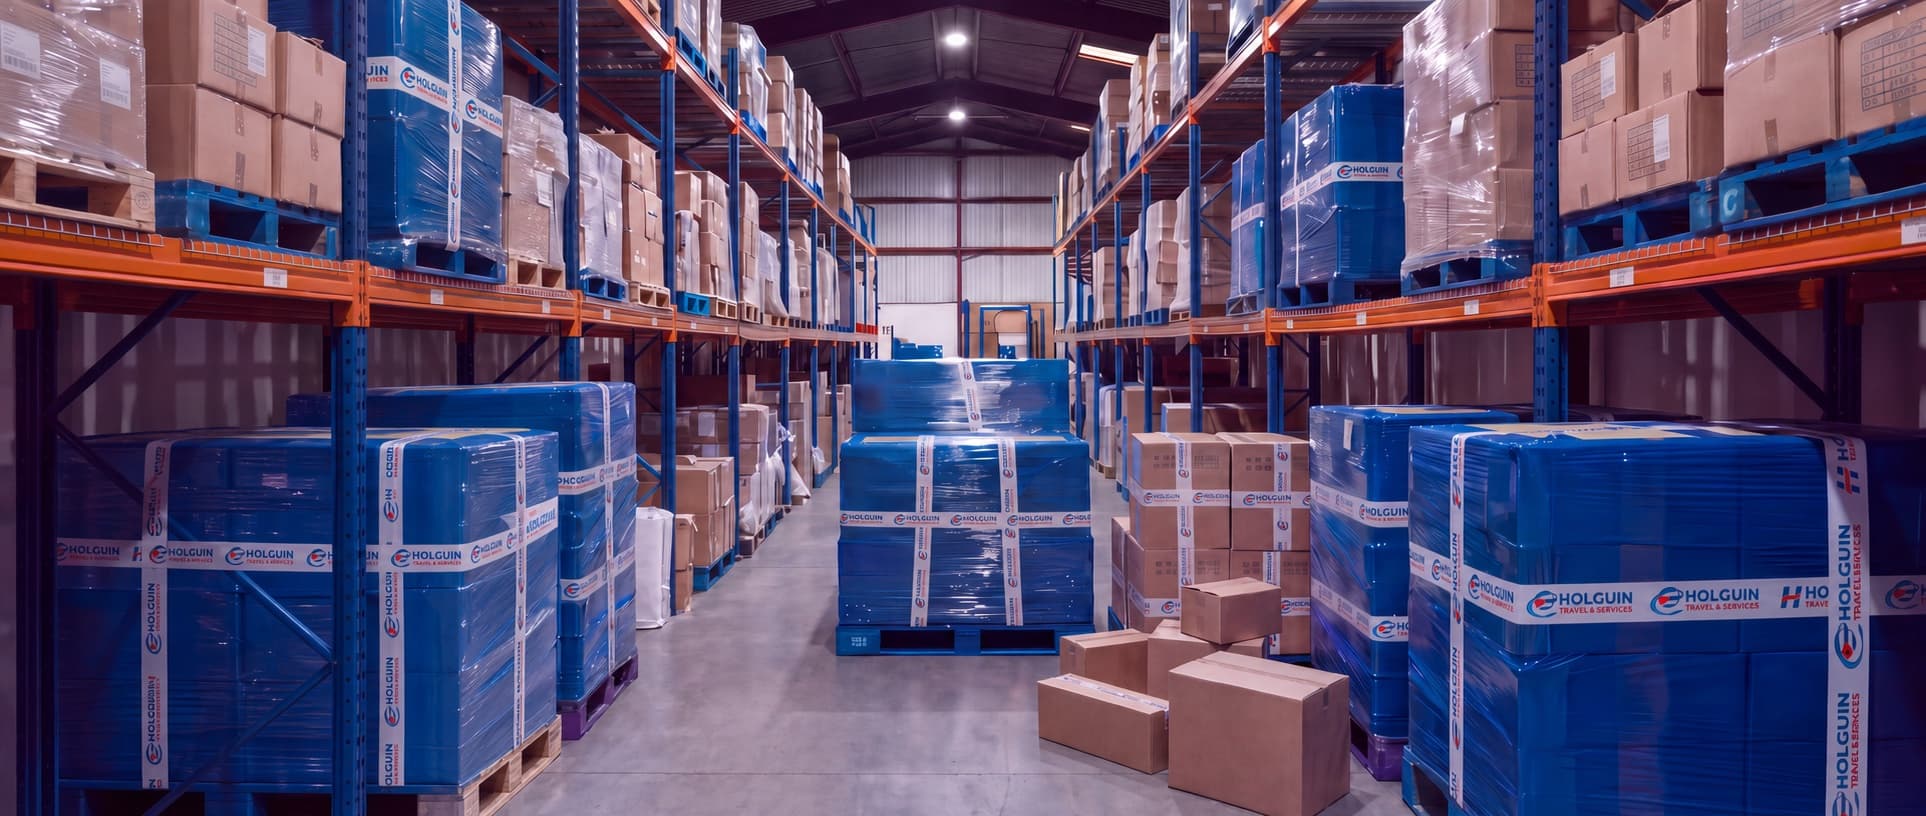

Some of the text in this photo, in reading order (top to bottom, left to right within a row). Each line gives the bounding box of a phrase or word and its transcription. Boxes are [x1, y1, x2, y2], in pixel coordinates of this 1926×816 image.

[1723, 188, 1739, 217] C
[68, 545, 120, 555] HOLGUIN
[168, 548, 214, 557] HOLGUIN
[246, 549, 294, 559] HOLGUIN
[412, 551, 462, 560] HOLGUIN
[1838, 525, 1851, 621] HOLGUIN
[1480, 581, 1514, 603] HOLGUIN
[1559, 592, 1633, 606] HOLGUIN
[1685, 588, 1759, 603] HOLGUIN
[1560, 607, 1588, 615] TRAVEL
[1685, 603, 1714, 611] TRAVEL
[385, 657, 393, 705] HOLGUIN
[1836, 692, 1850, 790] HOLGUIN
[385, 743, 393, 787] OLGUIN
